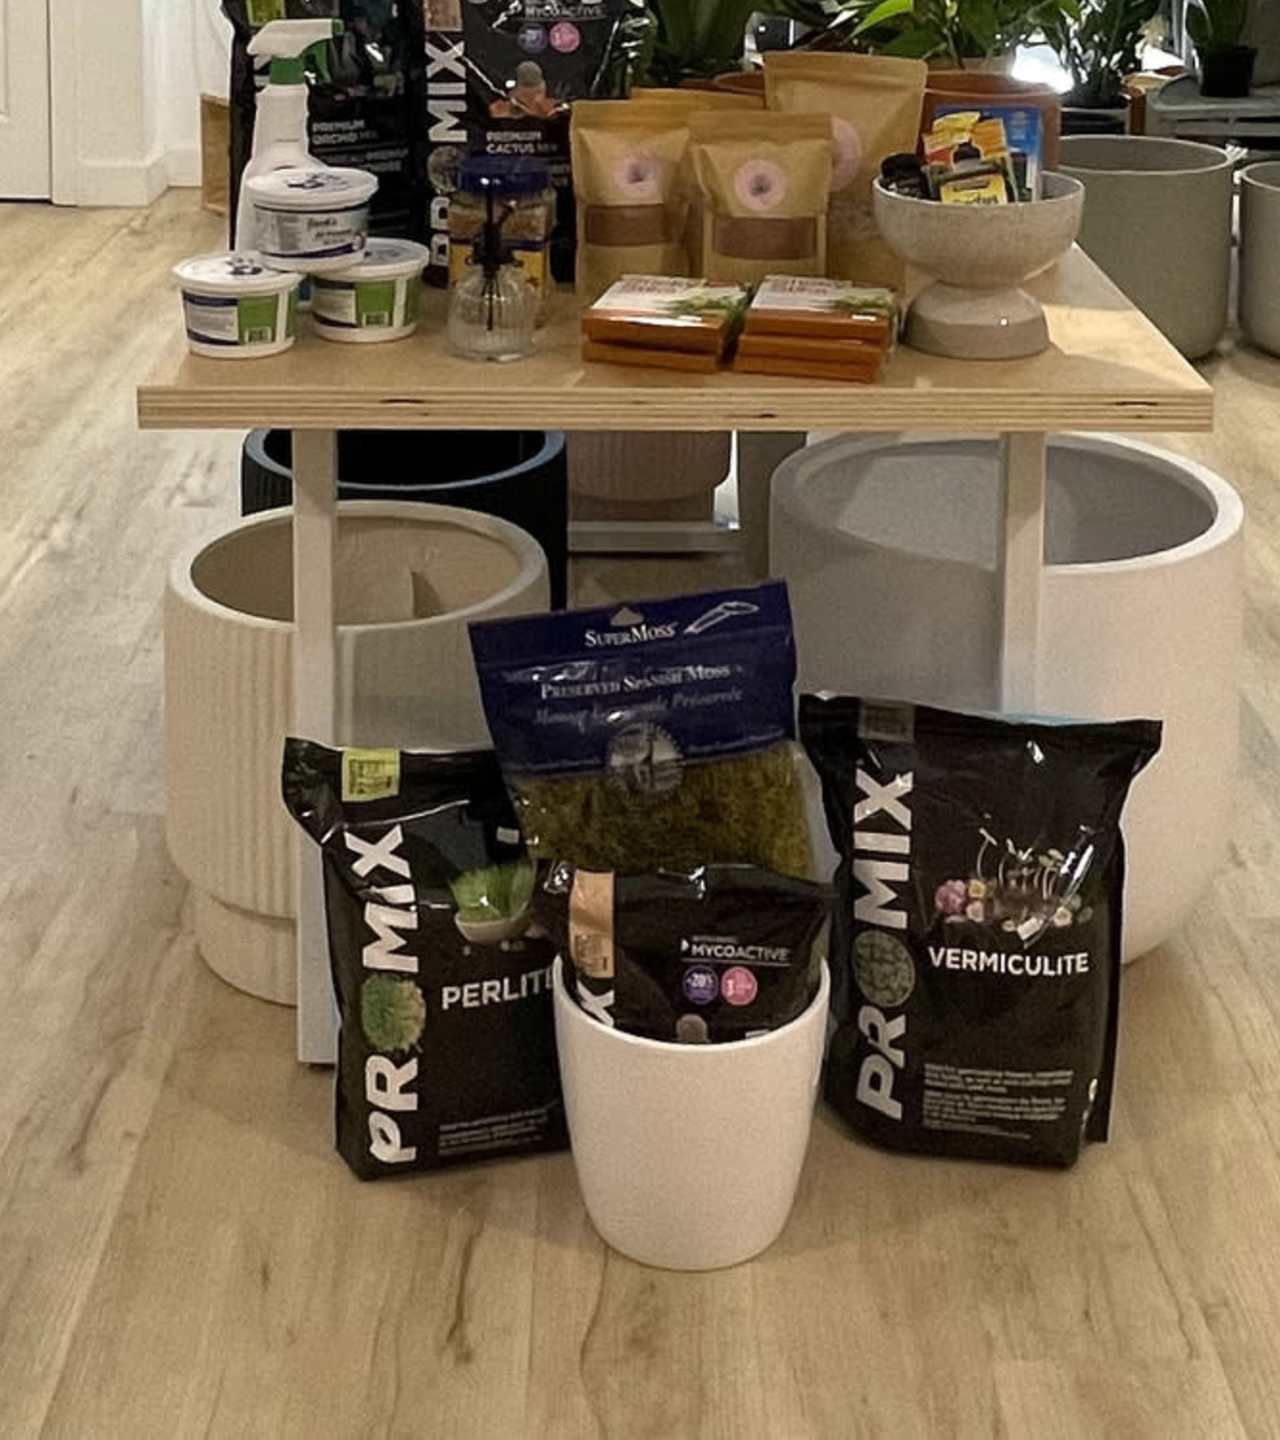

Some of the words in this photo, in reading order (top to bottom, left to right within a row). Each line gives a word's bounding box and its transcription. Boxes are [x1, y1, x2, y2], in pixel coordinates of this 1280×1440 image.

[424, 40, 468, 143] MIX
[486, 143, 535, 154] CACTUS
[853, 768, 914, 930] MIX
[344, 823, 418, 973] MIX
[691, 943, 790, 961] MYCOACTIVE
[928, 946, 1090, 977] VERMICULITE
